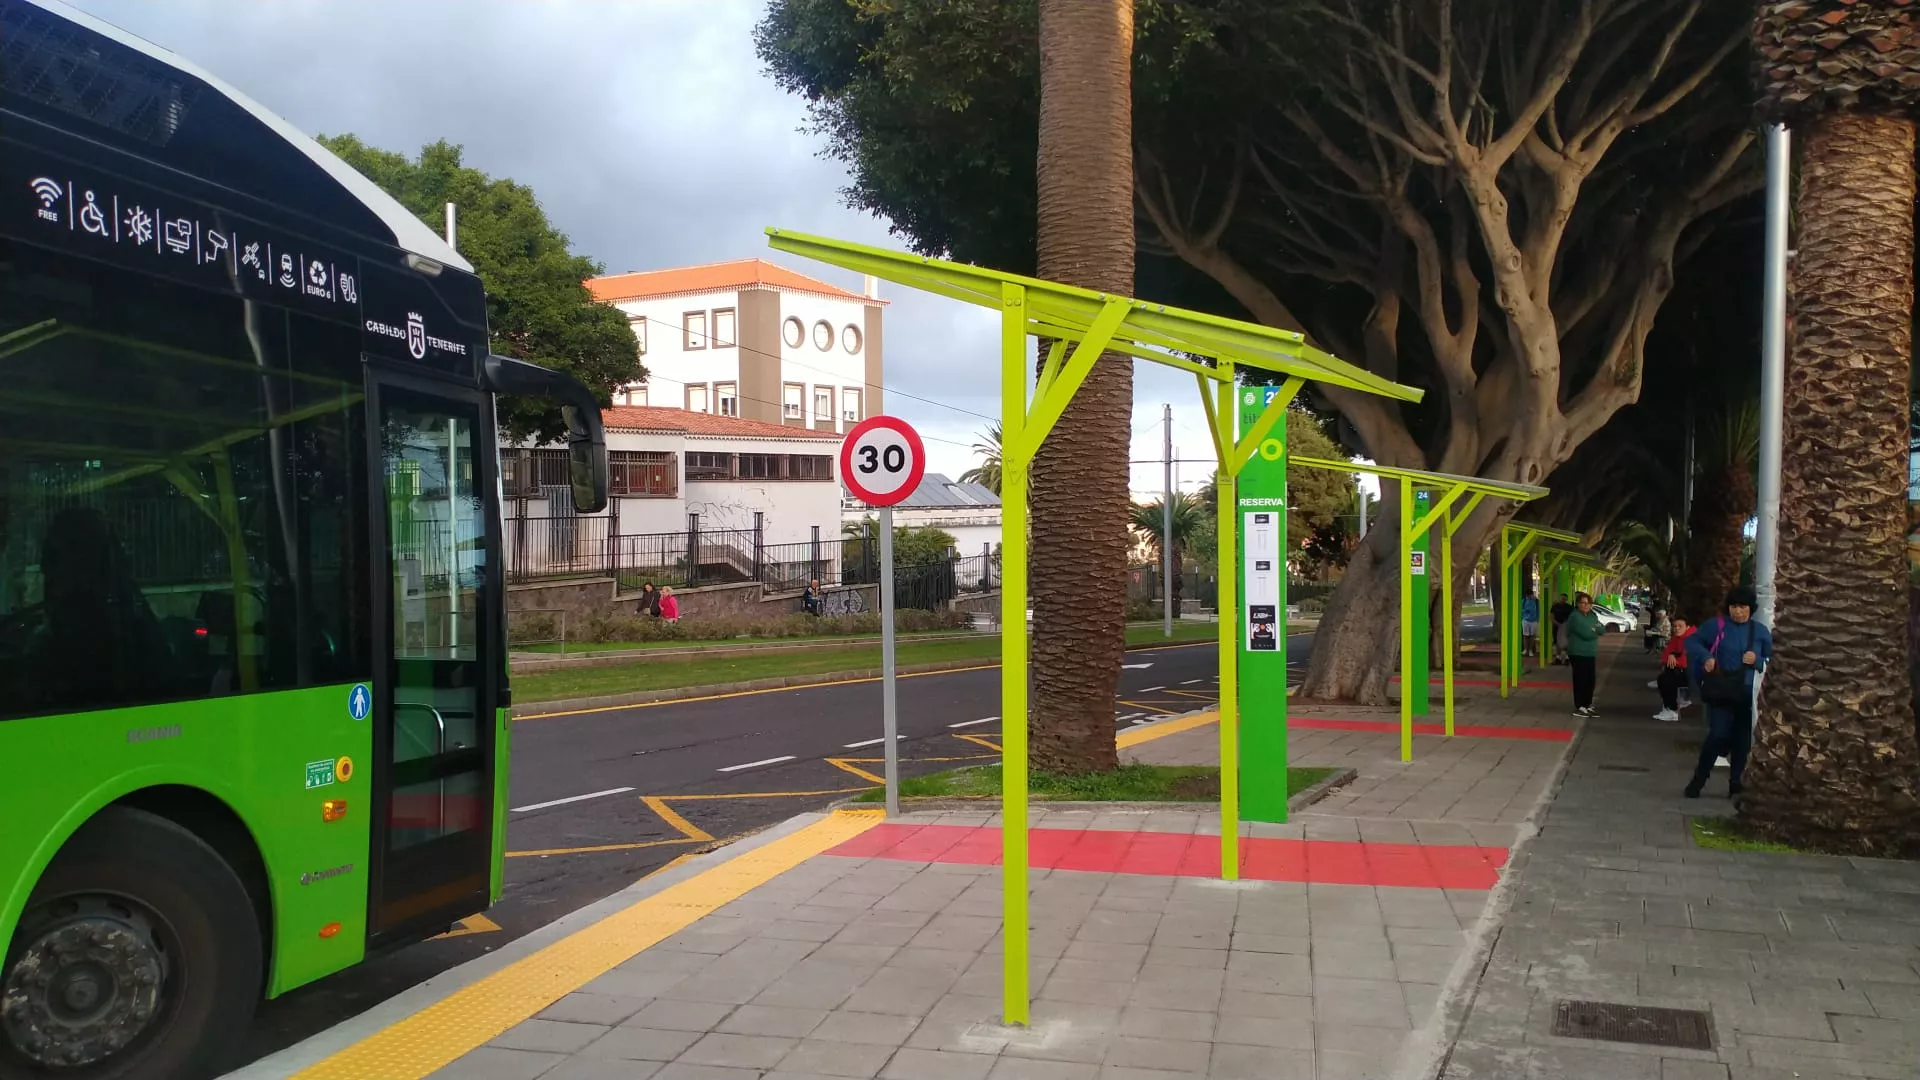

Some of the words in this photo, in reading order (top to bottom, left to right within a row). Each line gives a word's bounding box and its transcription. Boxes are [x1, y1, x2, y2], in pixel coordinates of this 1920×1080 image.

[38, 209, 57, 221] FREE
[307, 285, 326, 298] EURO
[326, 291, 331, 299] 6
[366, 320, 407, 340] CABILDO
[426, 335, 467, 355] TENERIFE
[858, 444, 905, 474] 30
[1239, 498, 1284, 506] RESERVA
